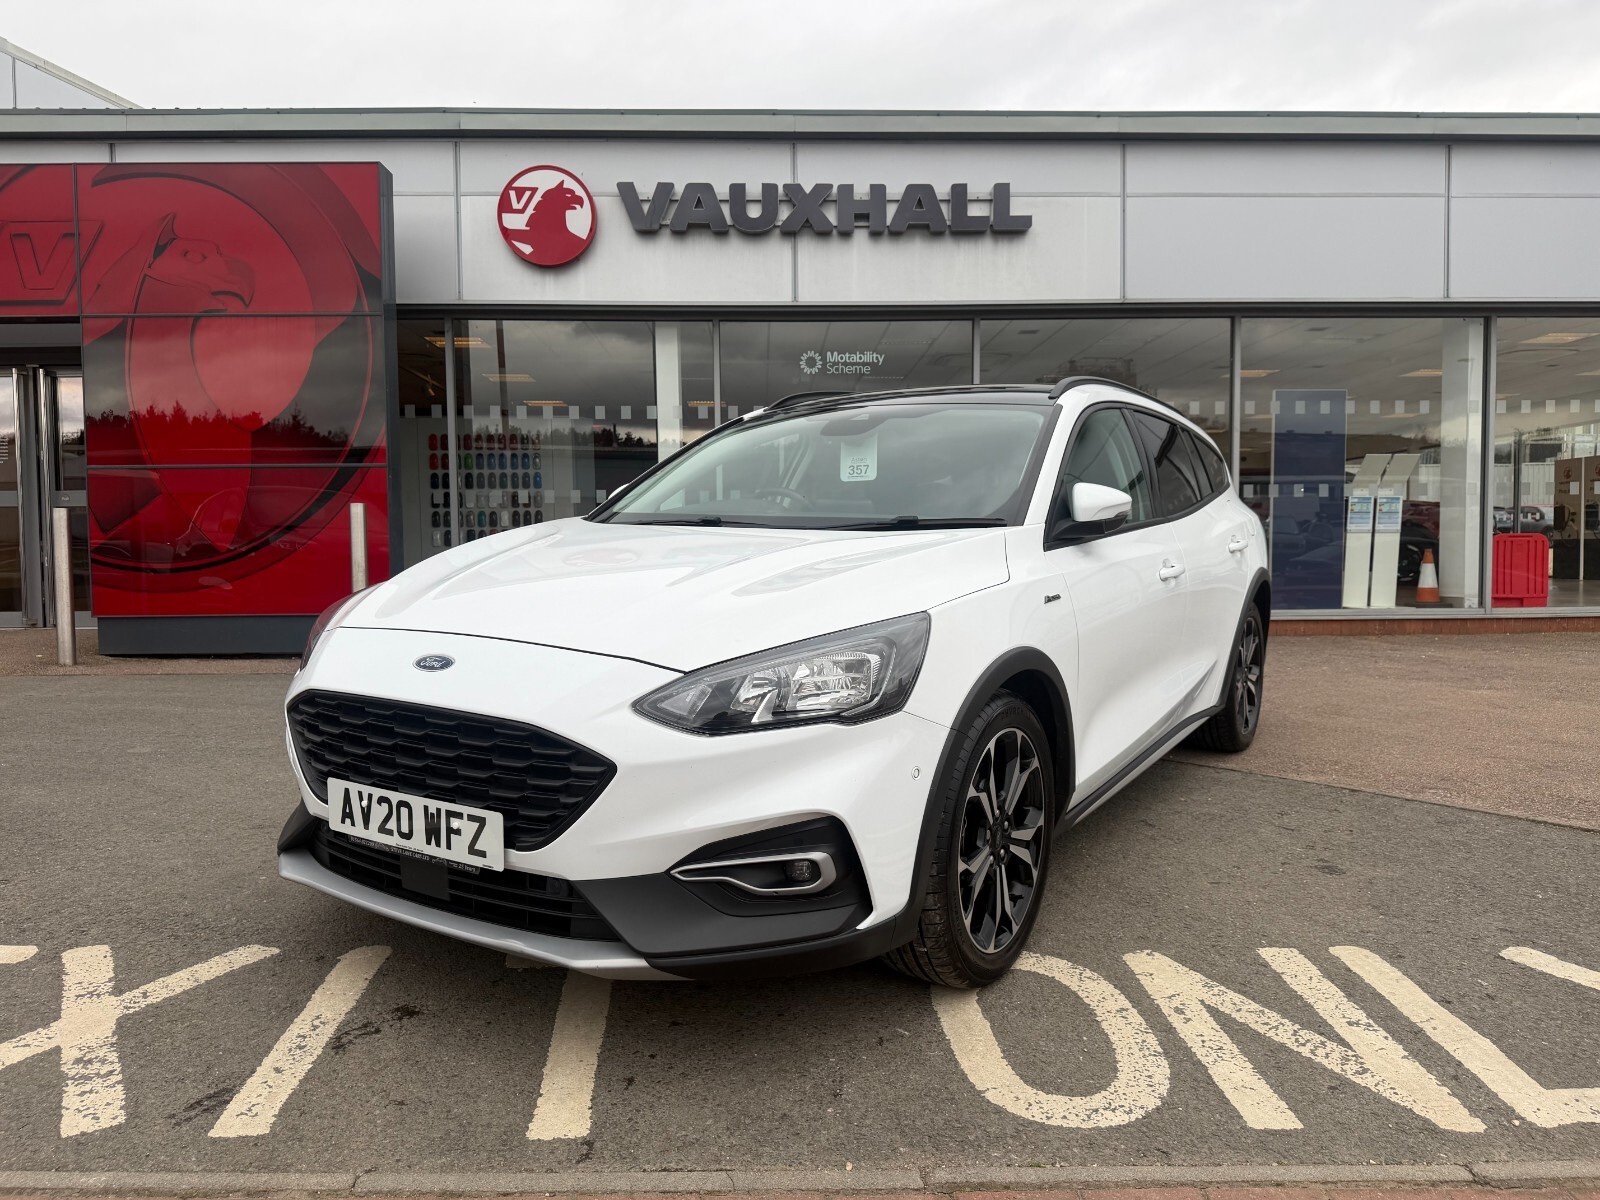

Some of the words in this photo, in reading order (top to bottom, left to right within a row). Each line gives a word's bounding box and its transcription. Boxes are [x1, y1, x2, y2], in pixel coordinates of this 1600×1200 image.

[616, 181, 1033, 235] VAUXHALL
[826, 351, 885, 366] Motability
[826, 362, 871, 375] Scheme
[848, 464, 870, 476] 357
[420, 656, 447, 668] Ford
[340, 787, 414, 841] AV20
[423, 804, 487, 859] WFZ
